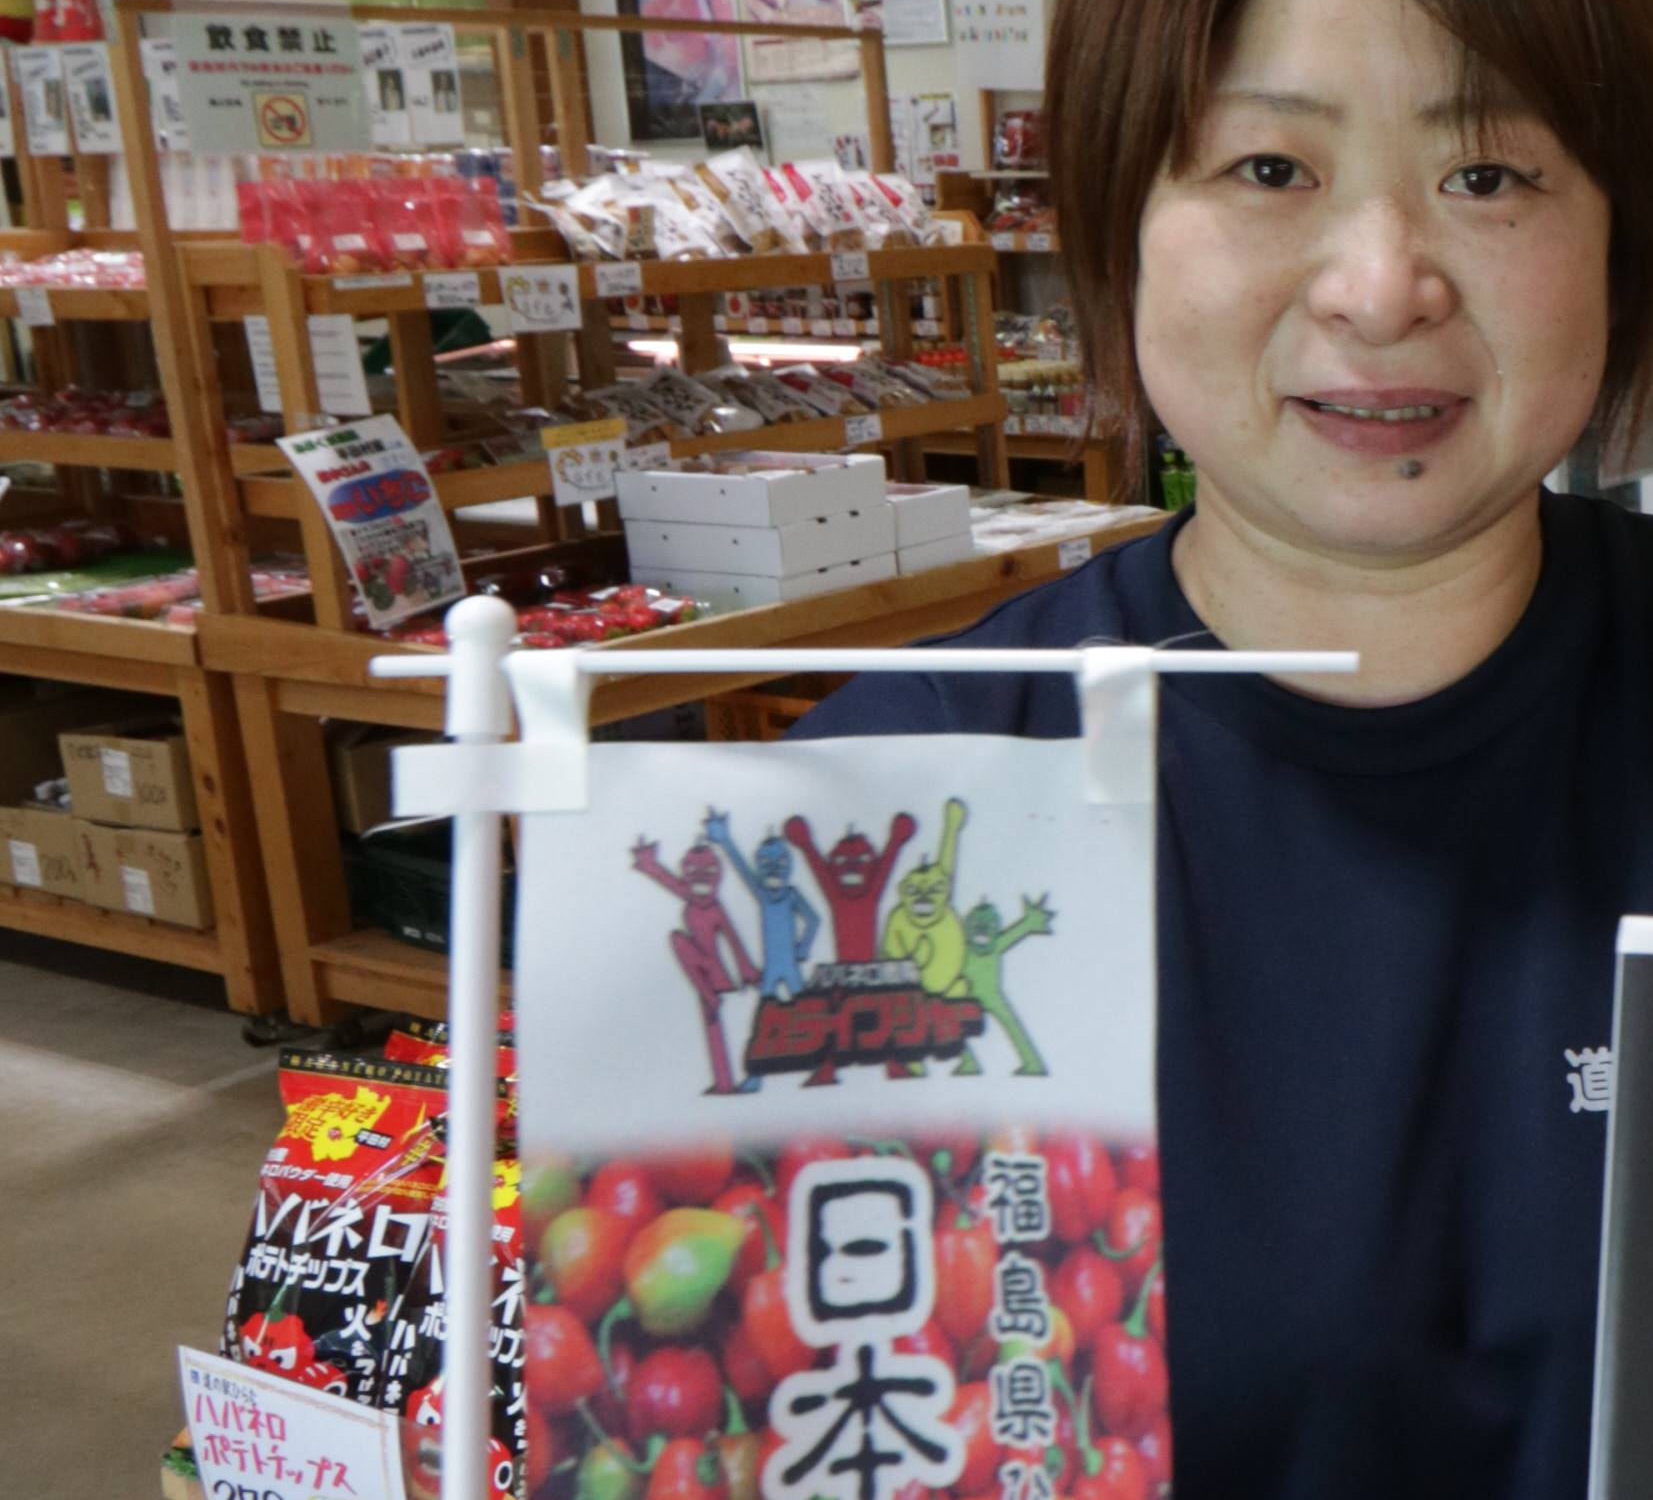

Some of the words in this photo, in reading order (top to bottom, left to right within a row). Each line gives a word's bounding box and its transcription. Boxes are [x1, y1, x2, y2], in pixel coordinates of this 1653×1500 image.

[205, 23, 336, 53] 飲食禁止
[245, 1242, 371, 1297] ポテトチップス
[194, 1392, 287, 1442] ハバネロ
[202, 1433, 358, 1496] ポテトチップス
